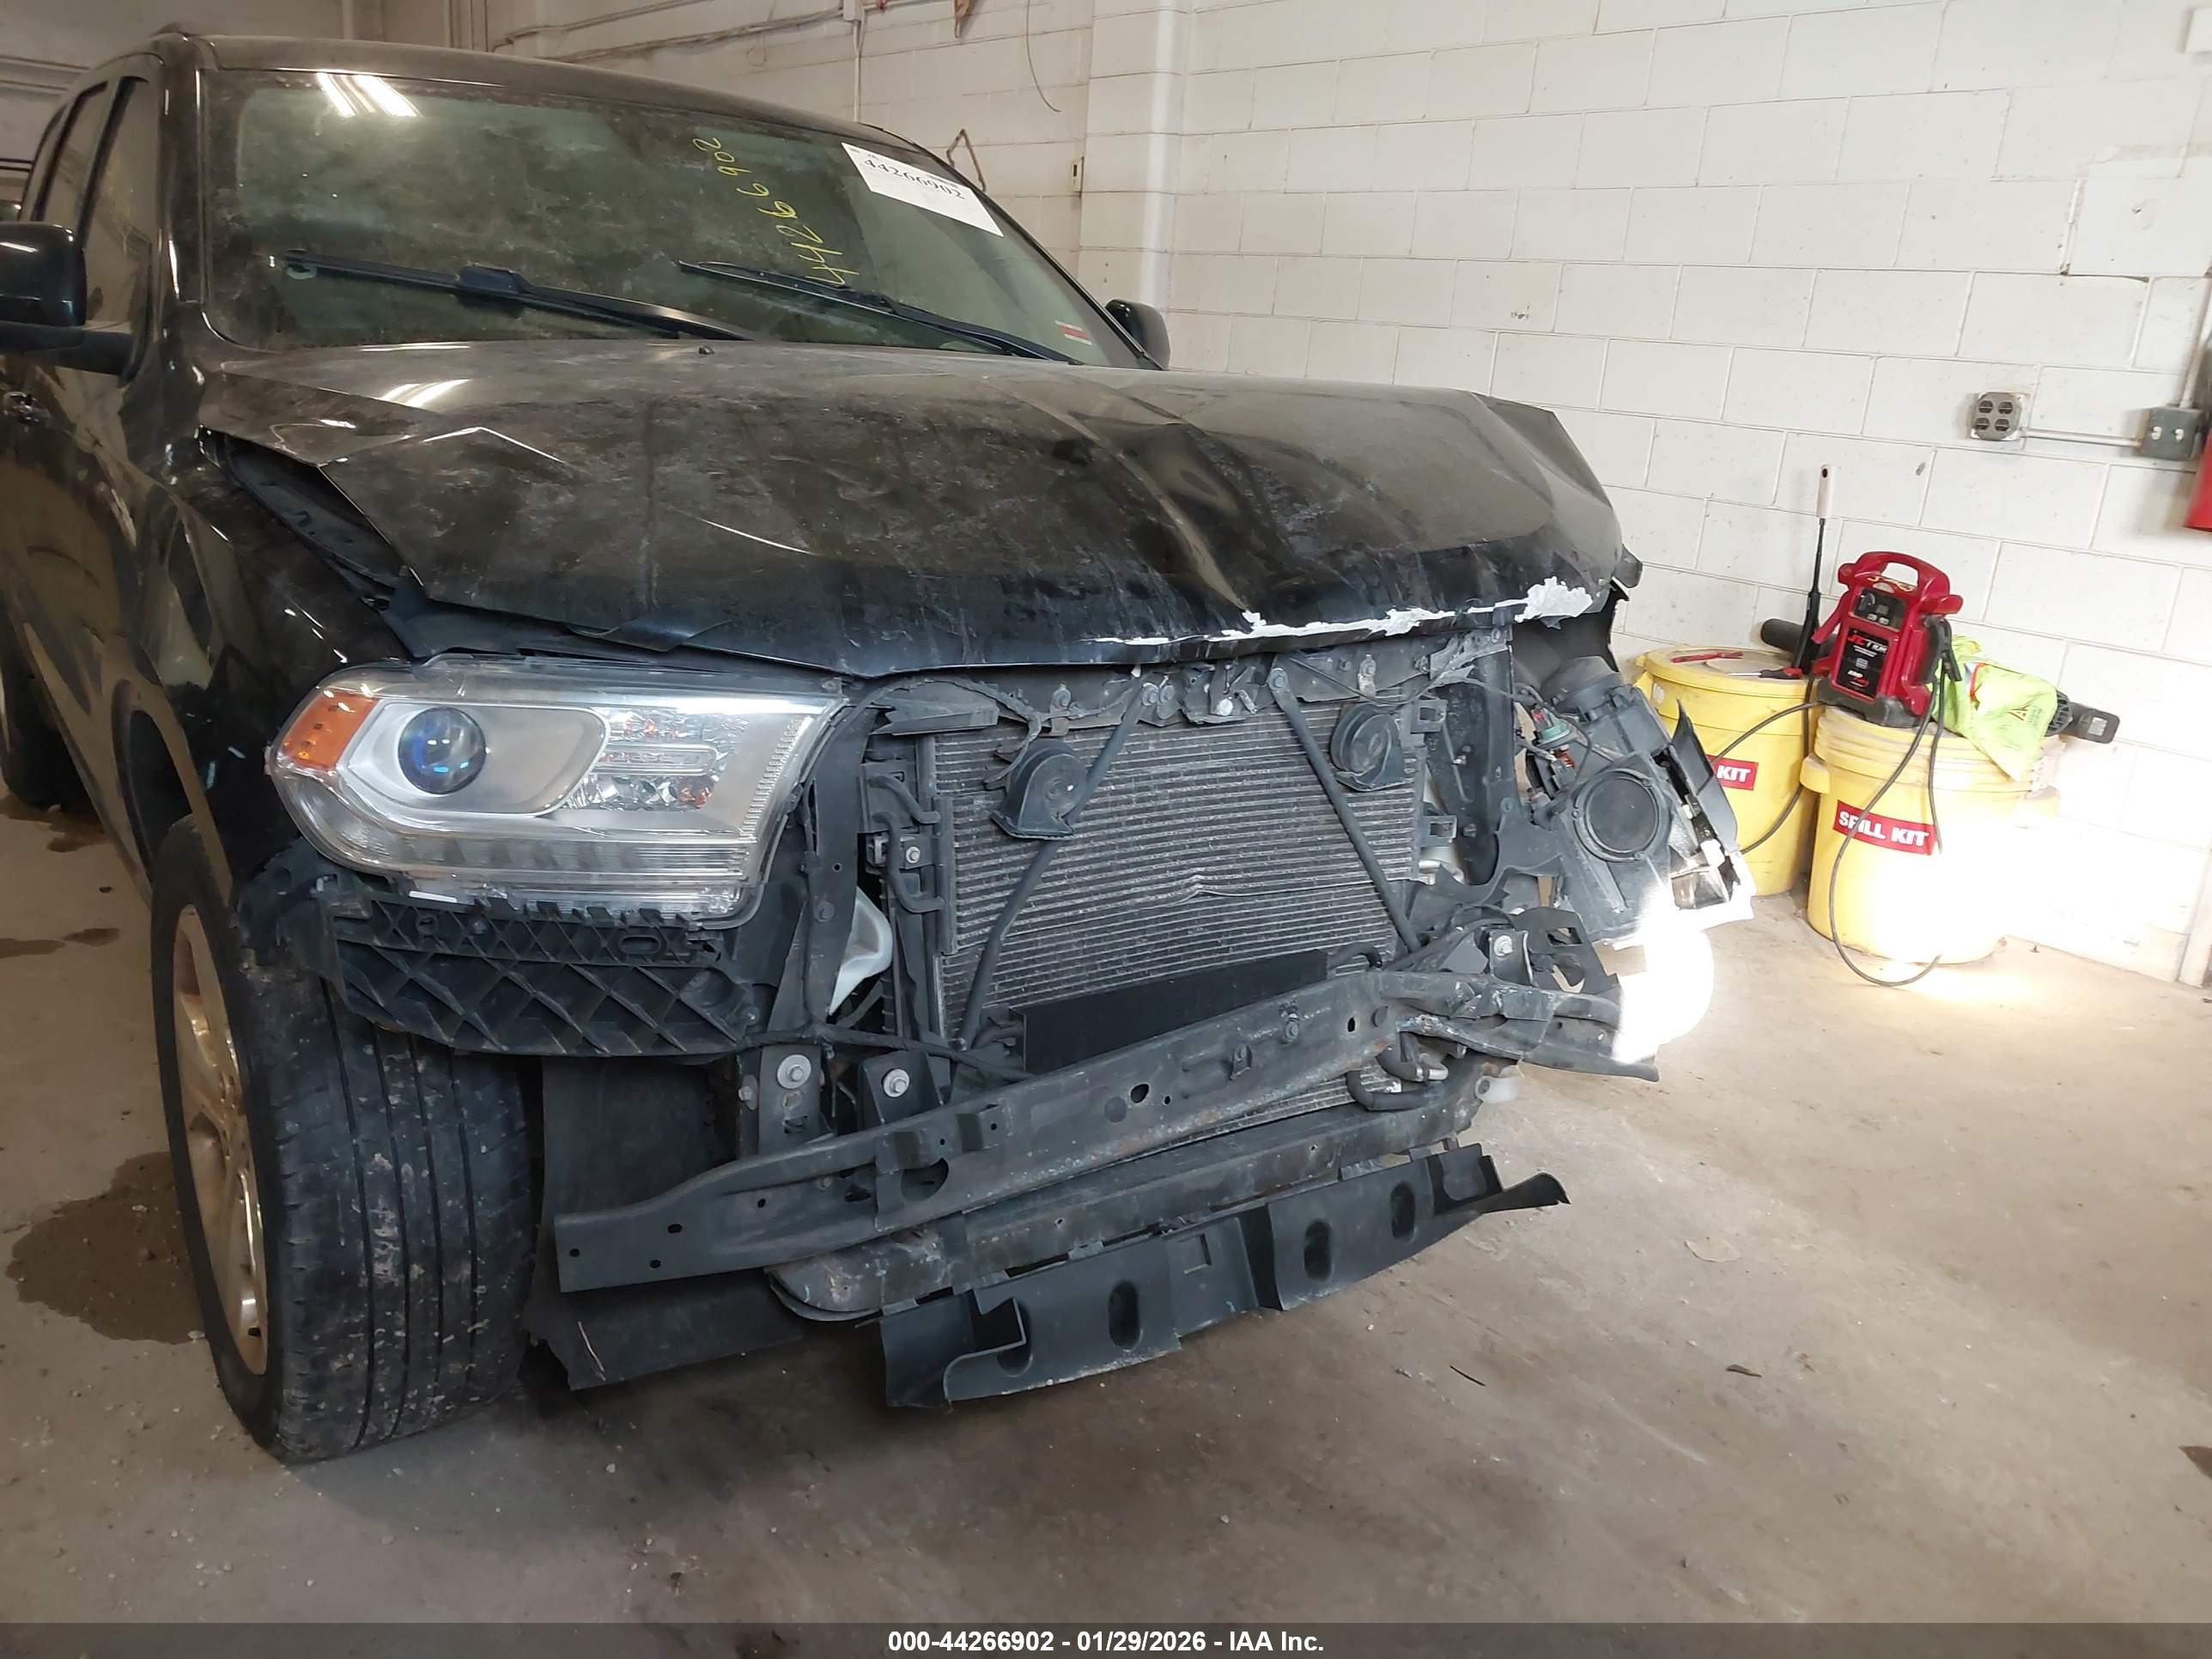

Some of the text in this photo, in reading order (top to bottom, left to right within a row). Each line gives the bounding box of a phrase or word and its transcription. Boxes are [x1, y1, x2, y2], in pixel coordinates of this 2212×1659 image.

[865, 159, 965, 200] 44266902
[1717, 764, 1752, 783] KIT
[1891, 826, 1929, 847] KIT
